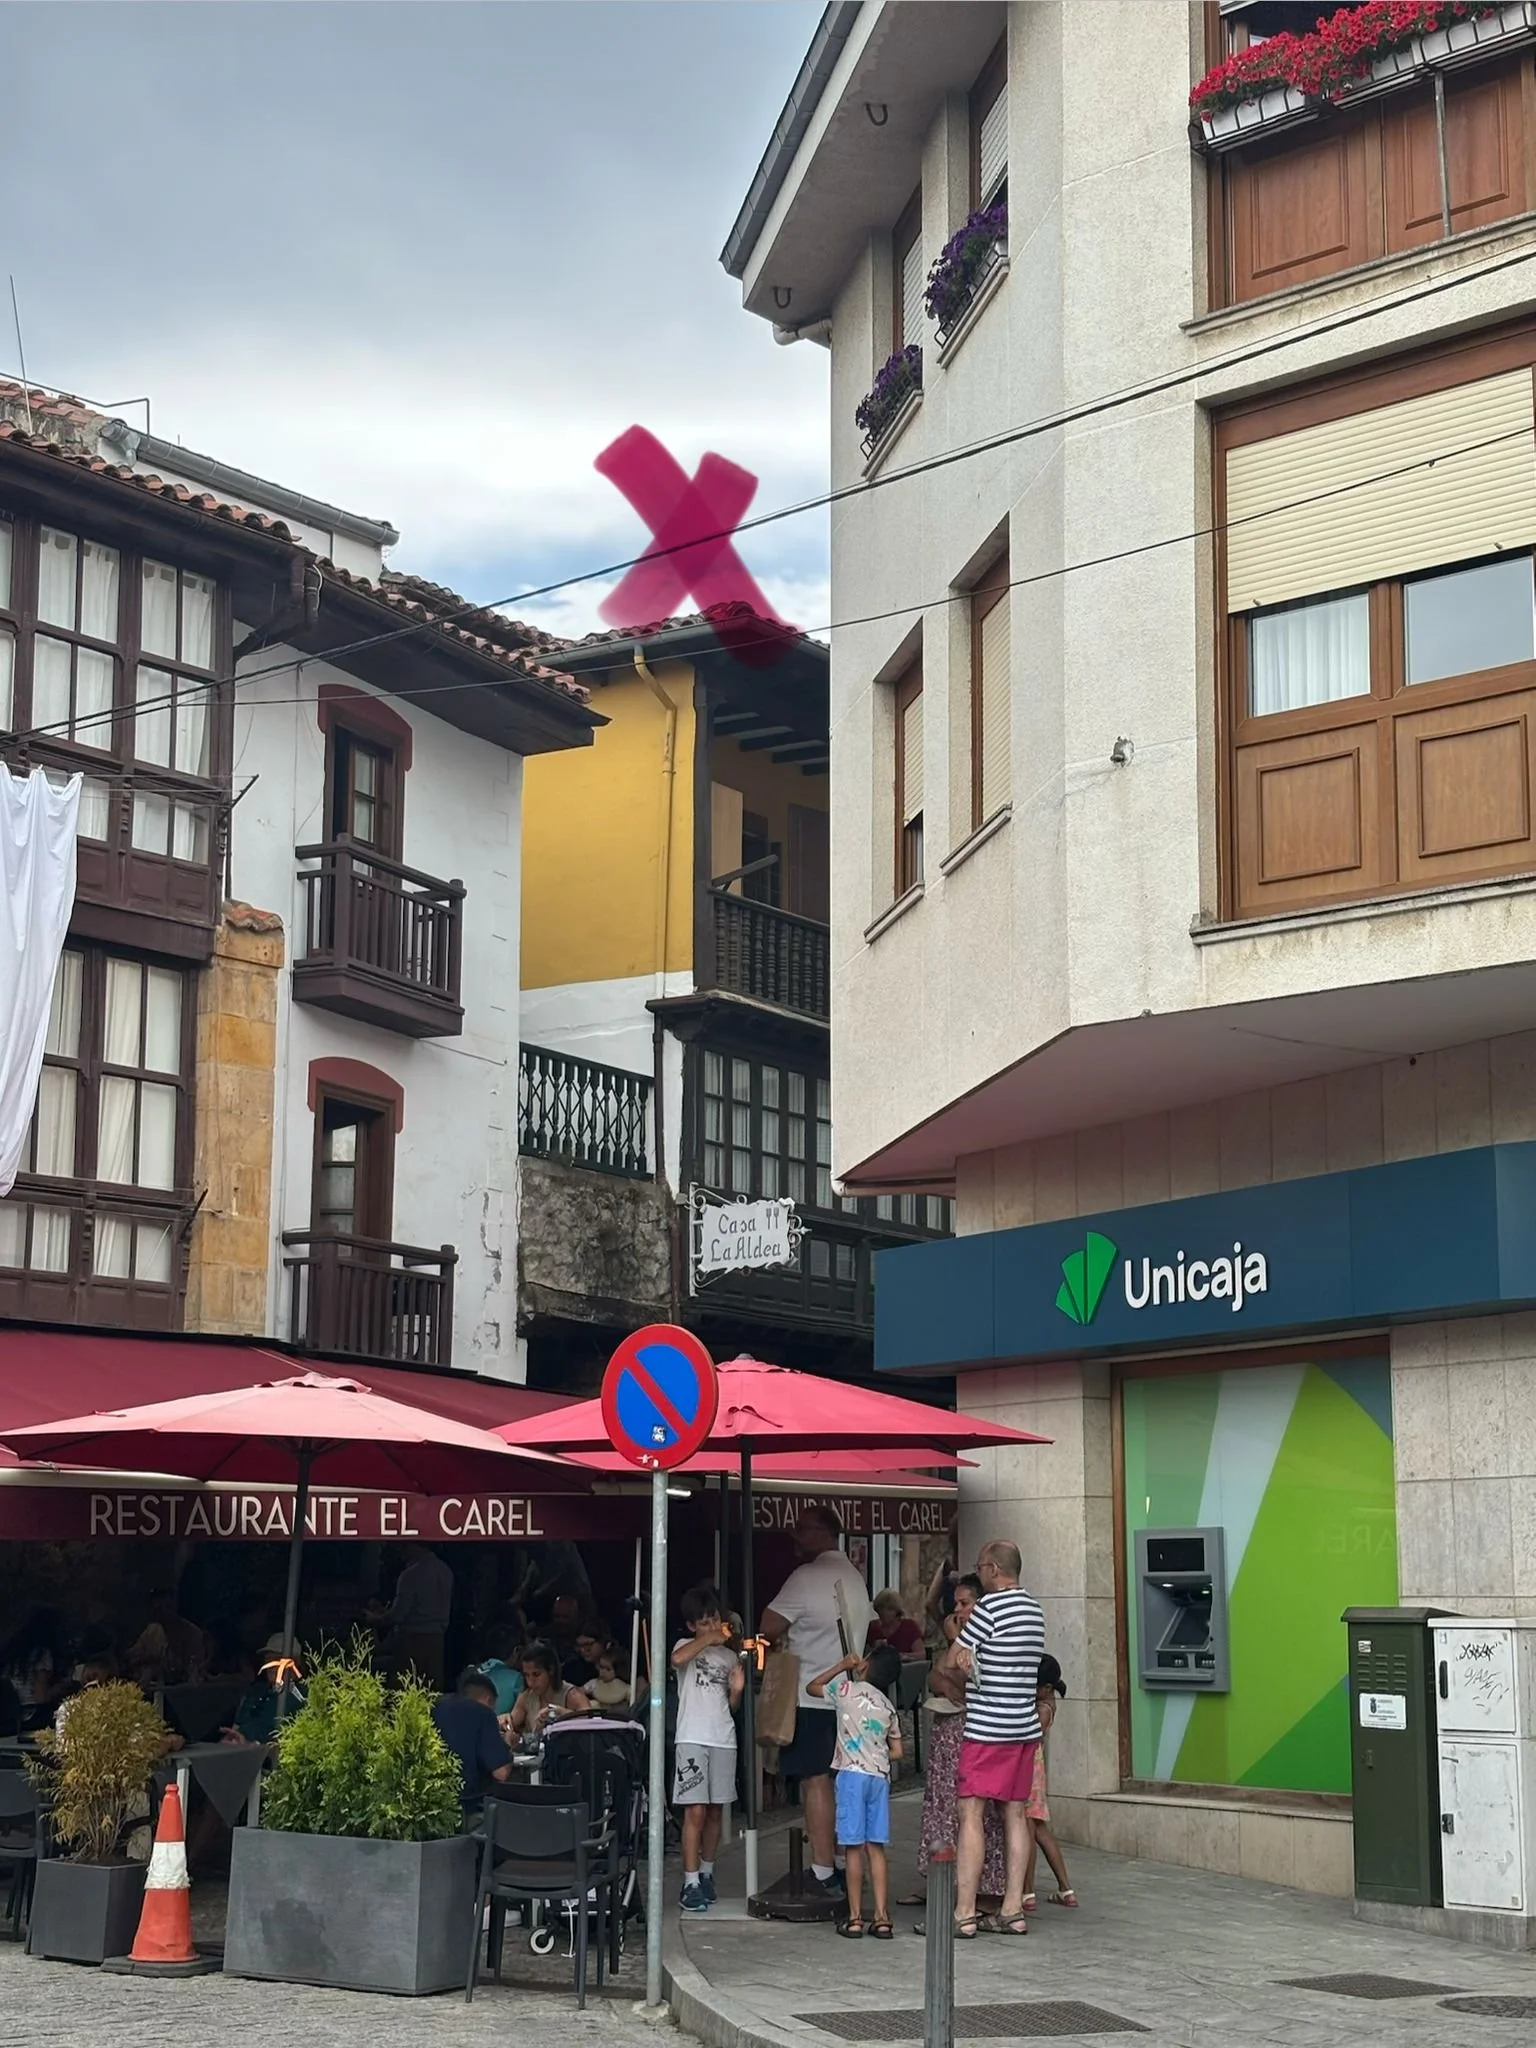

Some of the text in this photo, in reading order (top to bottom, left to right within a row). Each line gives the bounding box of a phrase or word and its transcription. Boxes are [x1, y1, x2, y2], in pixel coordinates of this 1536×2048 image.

[718, 1213, 757, 1235] Casa
[1124, 1241, 1268, 1312] Unicaja
[89, 1494, 545, 1537] RESTAURANTE EL CAREL
[740, 1495, 949, 1532] ESTANTE EL CAREL
